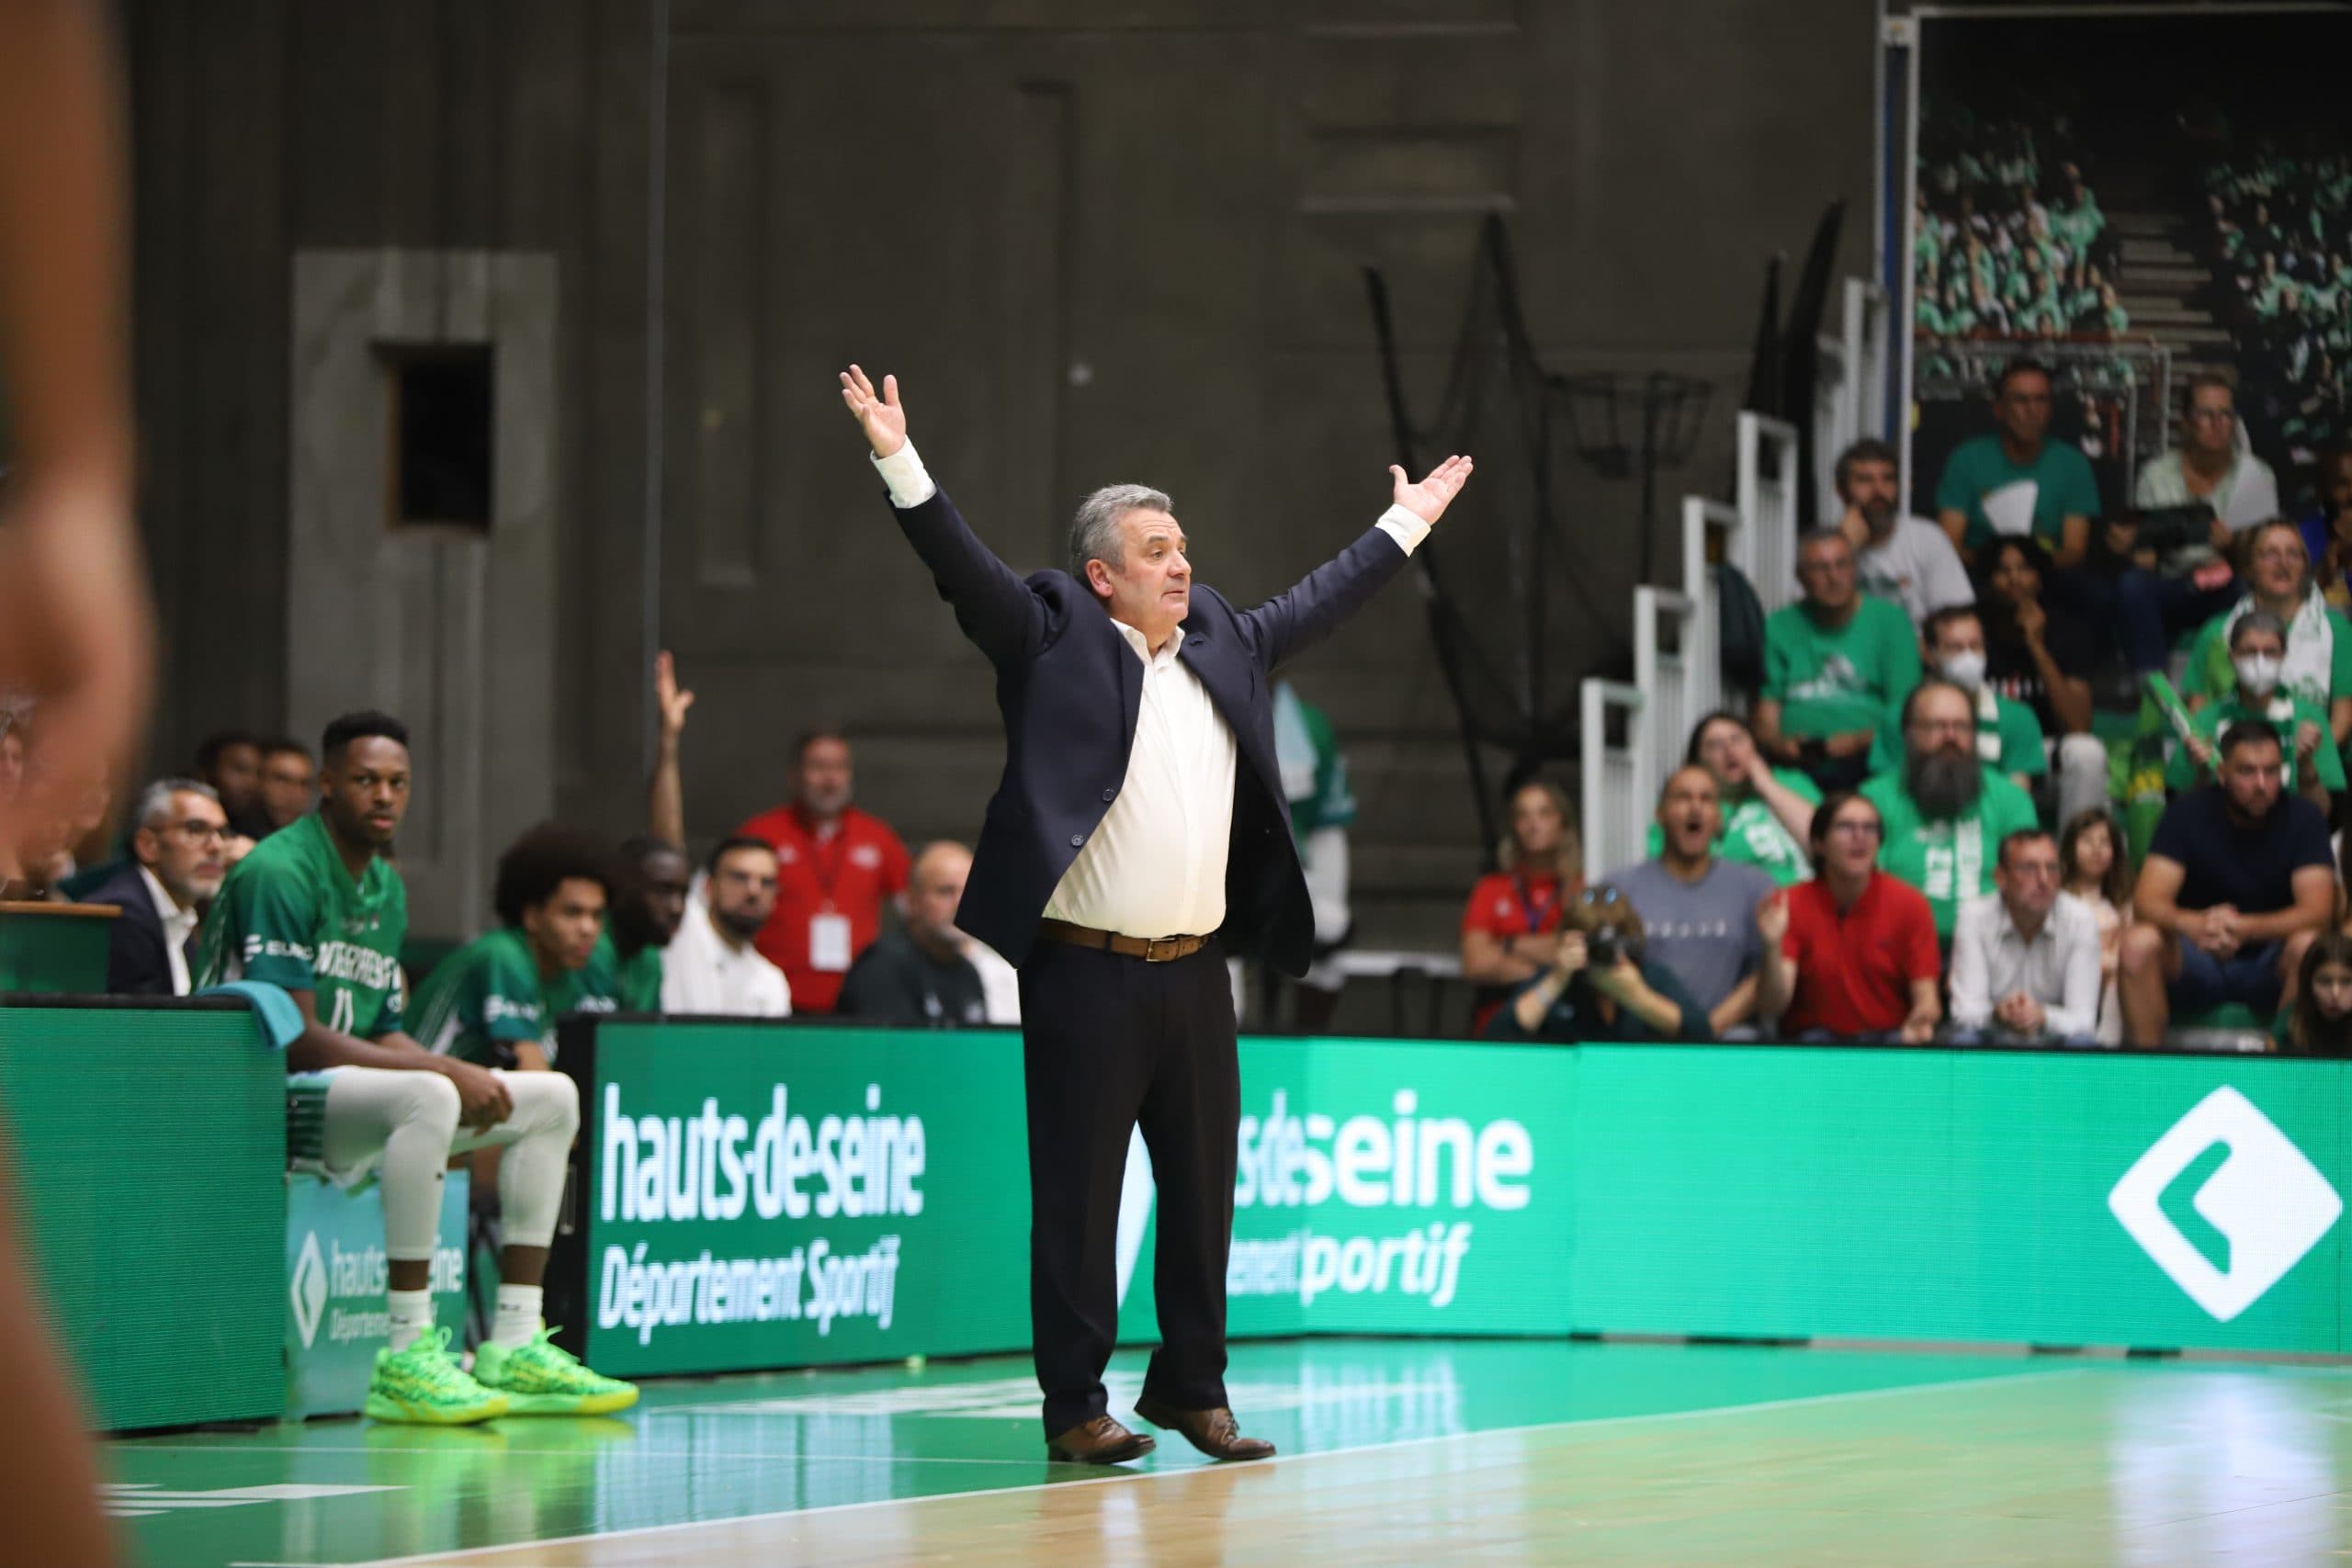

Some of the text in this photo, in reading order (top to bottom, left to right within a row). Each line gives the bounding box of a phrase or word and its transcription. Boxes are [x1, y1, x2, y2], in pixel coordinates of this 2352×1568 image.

[598, 1235, 901, 1346] Département Sportif
[1298, 1224, 1473, 1308] portif
